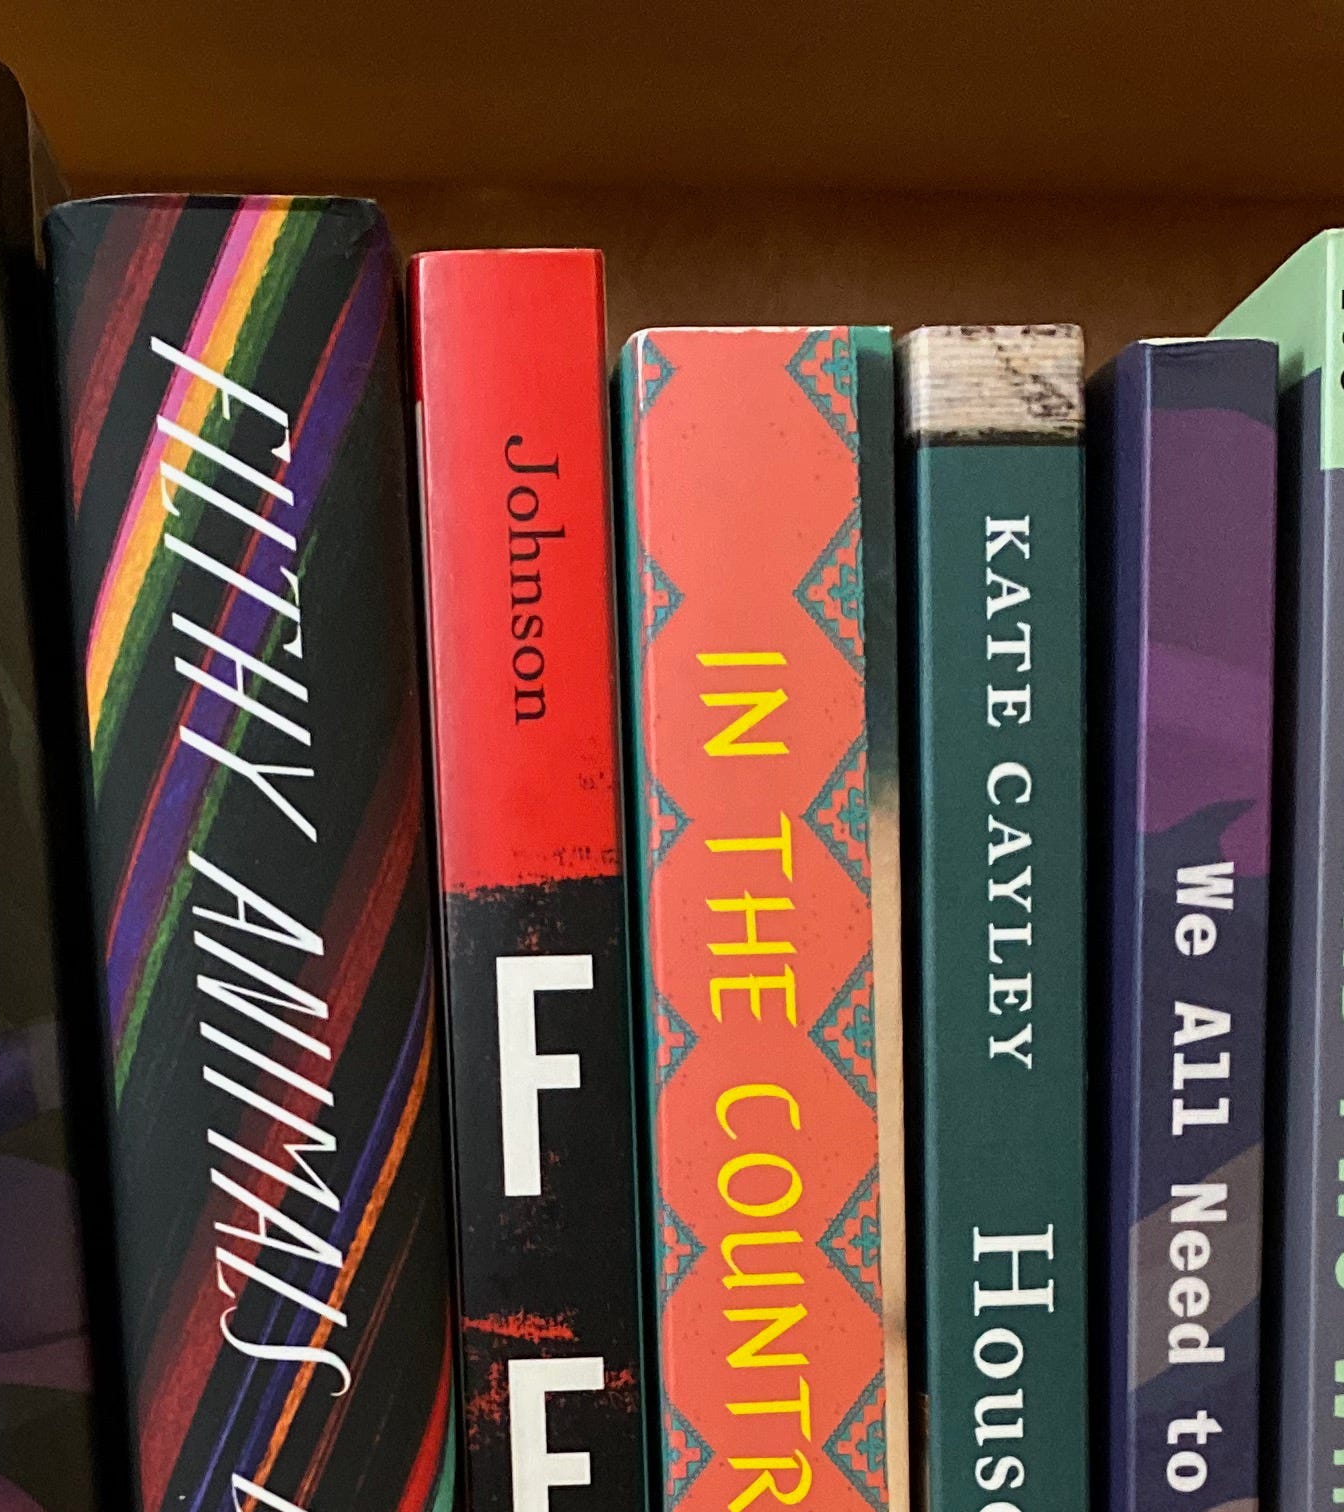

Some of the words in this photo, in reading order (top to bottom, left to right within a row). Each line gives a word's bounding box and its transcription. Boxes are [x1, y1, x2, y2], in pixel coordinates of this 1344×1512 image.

[150, 336, 318, 843] FILTHY
[505, 434, 566, 726] Johnson
[985, 514, 1032, 728] KATE
[696, 652, 790, 757] IN
[704, 811, 797, 1028] THE
[986, 761, 1033, 1070] CAYLEY
[1173, 861, 1235, 957] We
[187, 850, 352, 1397] ANIMALS
[1171, 1000, 1232, 1137] All
[1167, 1183, 1228, 1366] Need
[1164, 1409, 1224, 1494] to
